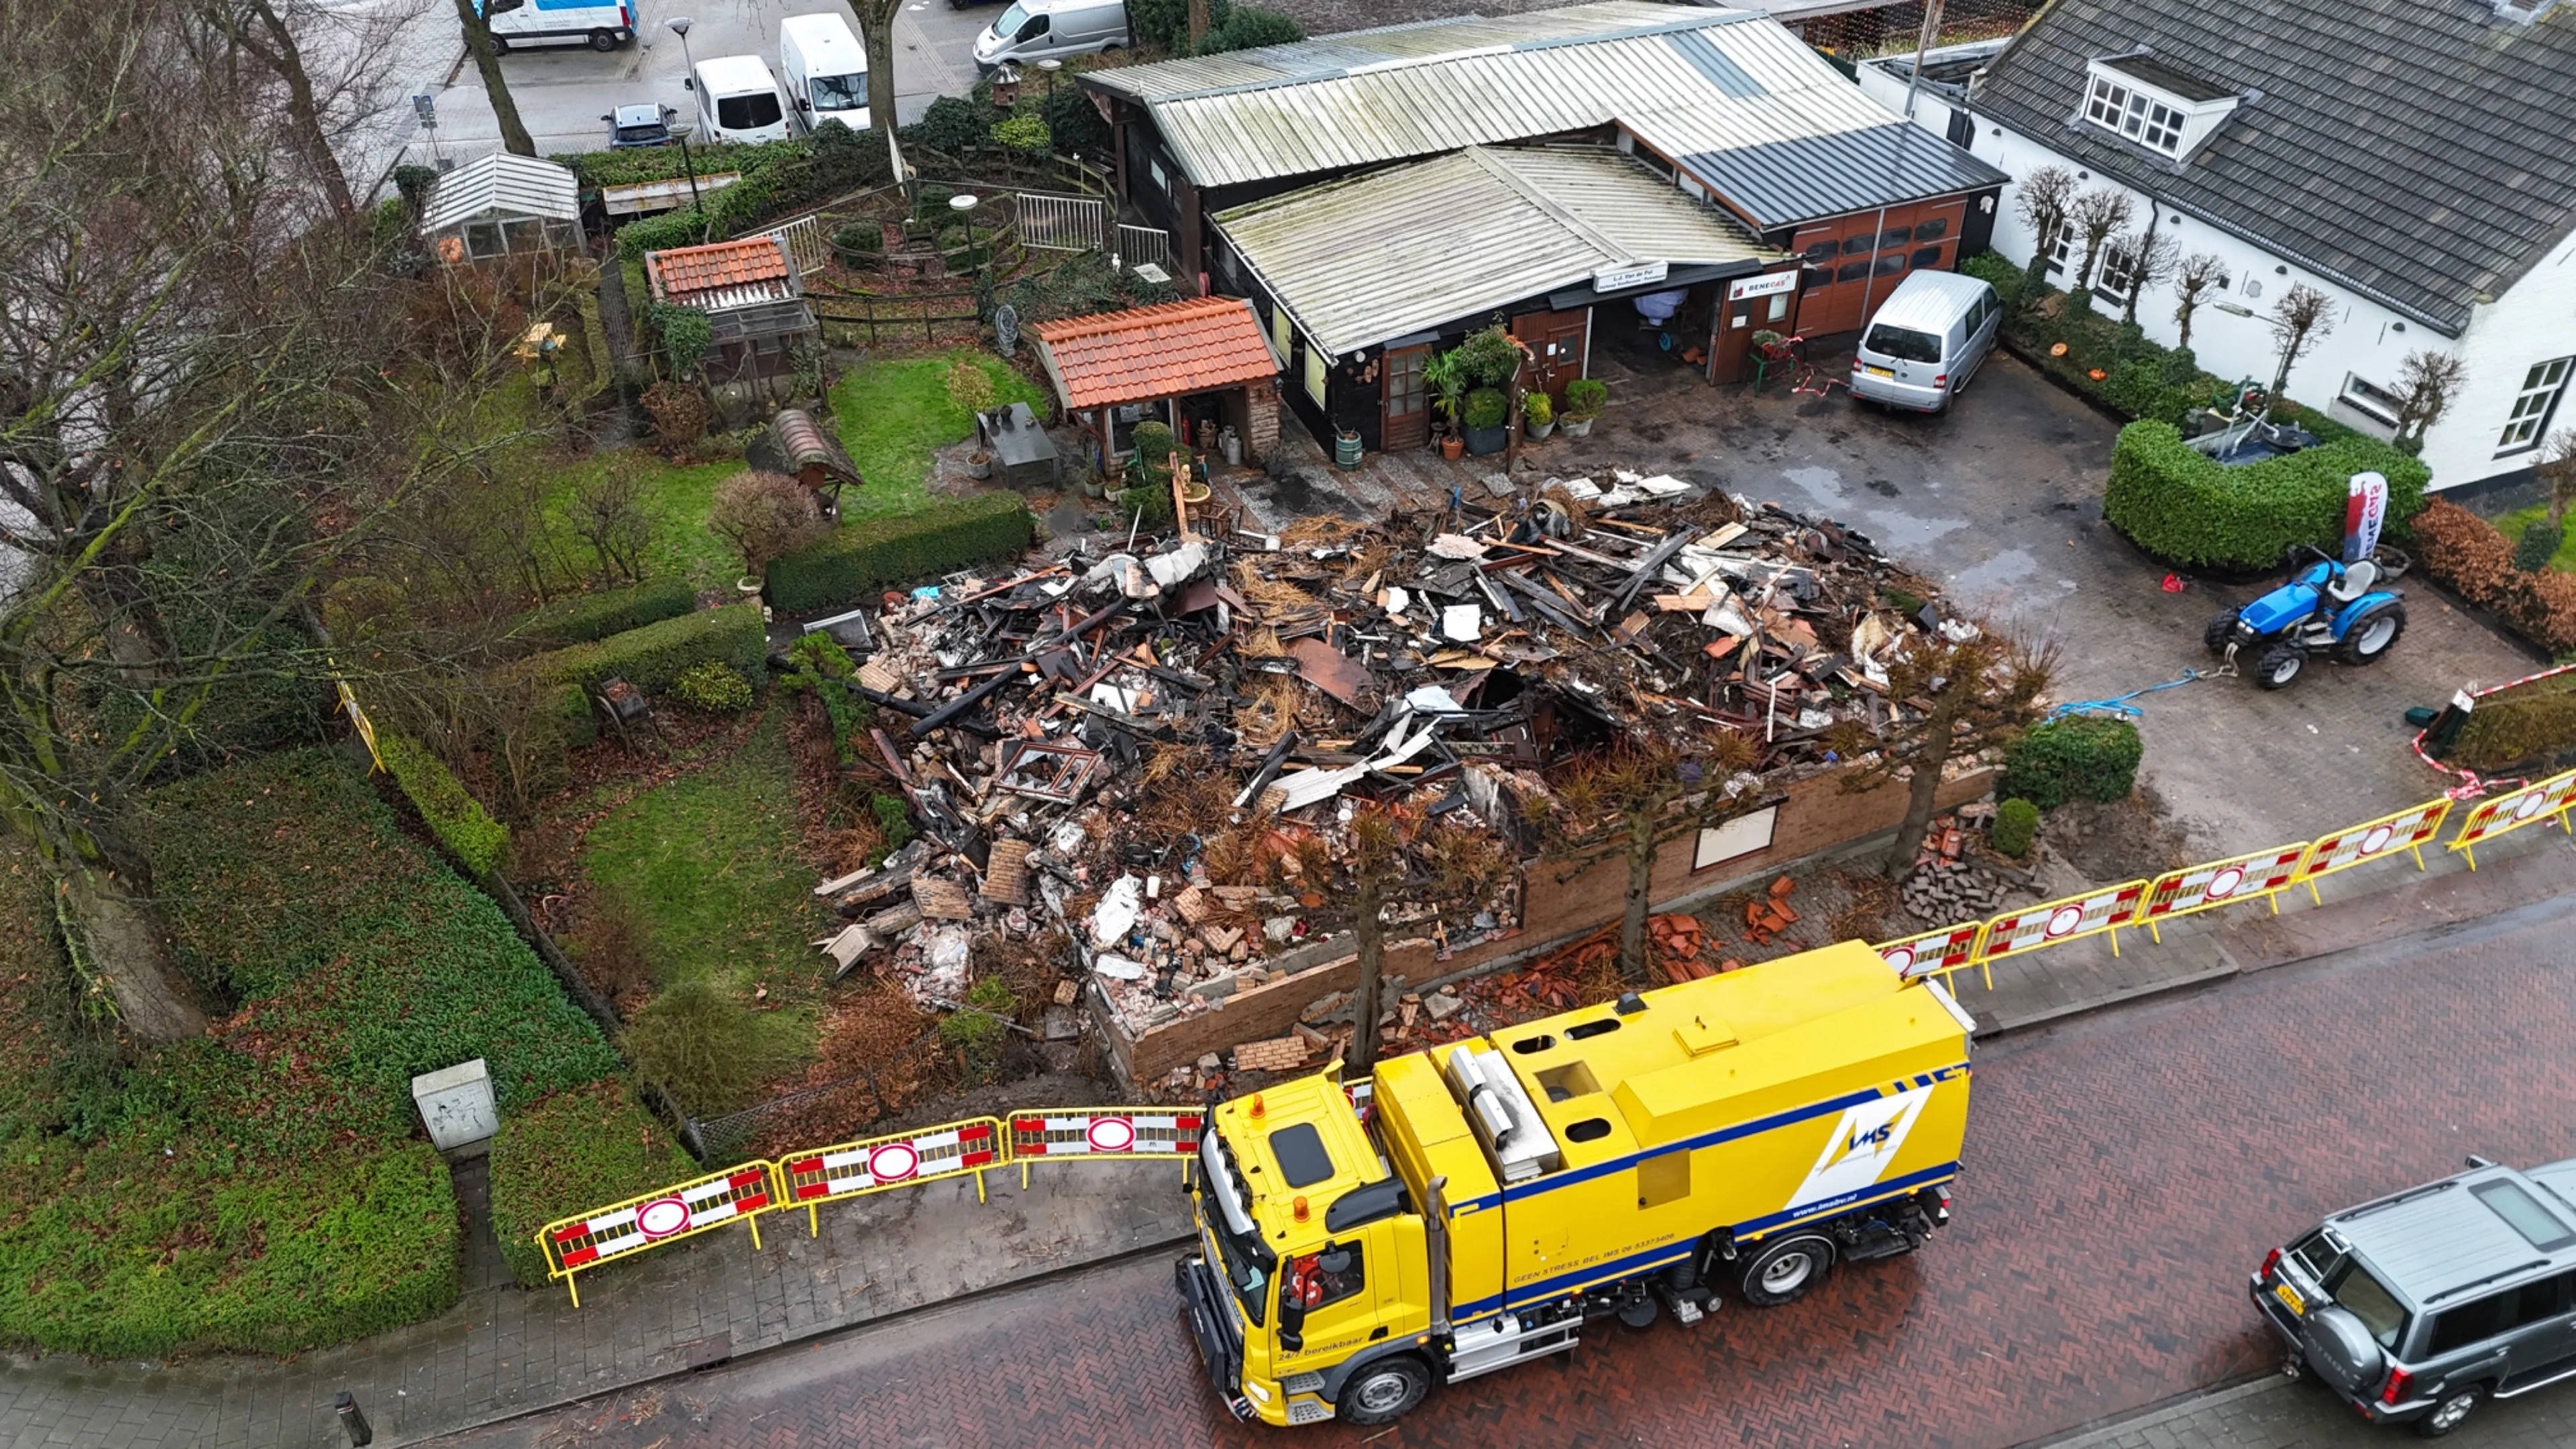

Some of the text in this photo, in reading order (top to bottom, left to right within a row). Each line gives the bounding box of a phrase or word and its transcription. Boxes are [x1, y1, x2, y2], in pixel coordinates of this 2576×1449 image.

[1849, 1122, 1895, 1151] IMS
[1513, 1271, 1540, 1283] GEEN
[1542, 1260, 1579, 1275] STRESS
[1582, 1254, 1599, 1264] BEL
[1603, 1248, 1619, 1258] IMS
[1278, 1336, 1364, 1361] 24/7 bereikbaar
